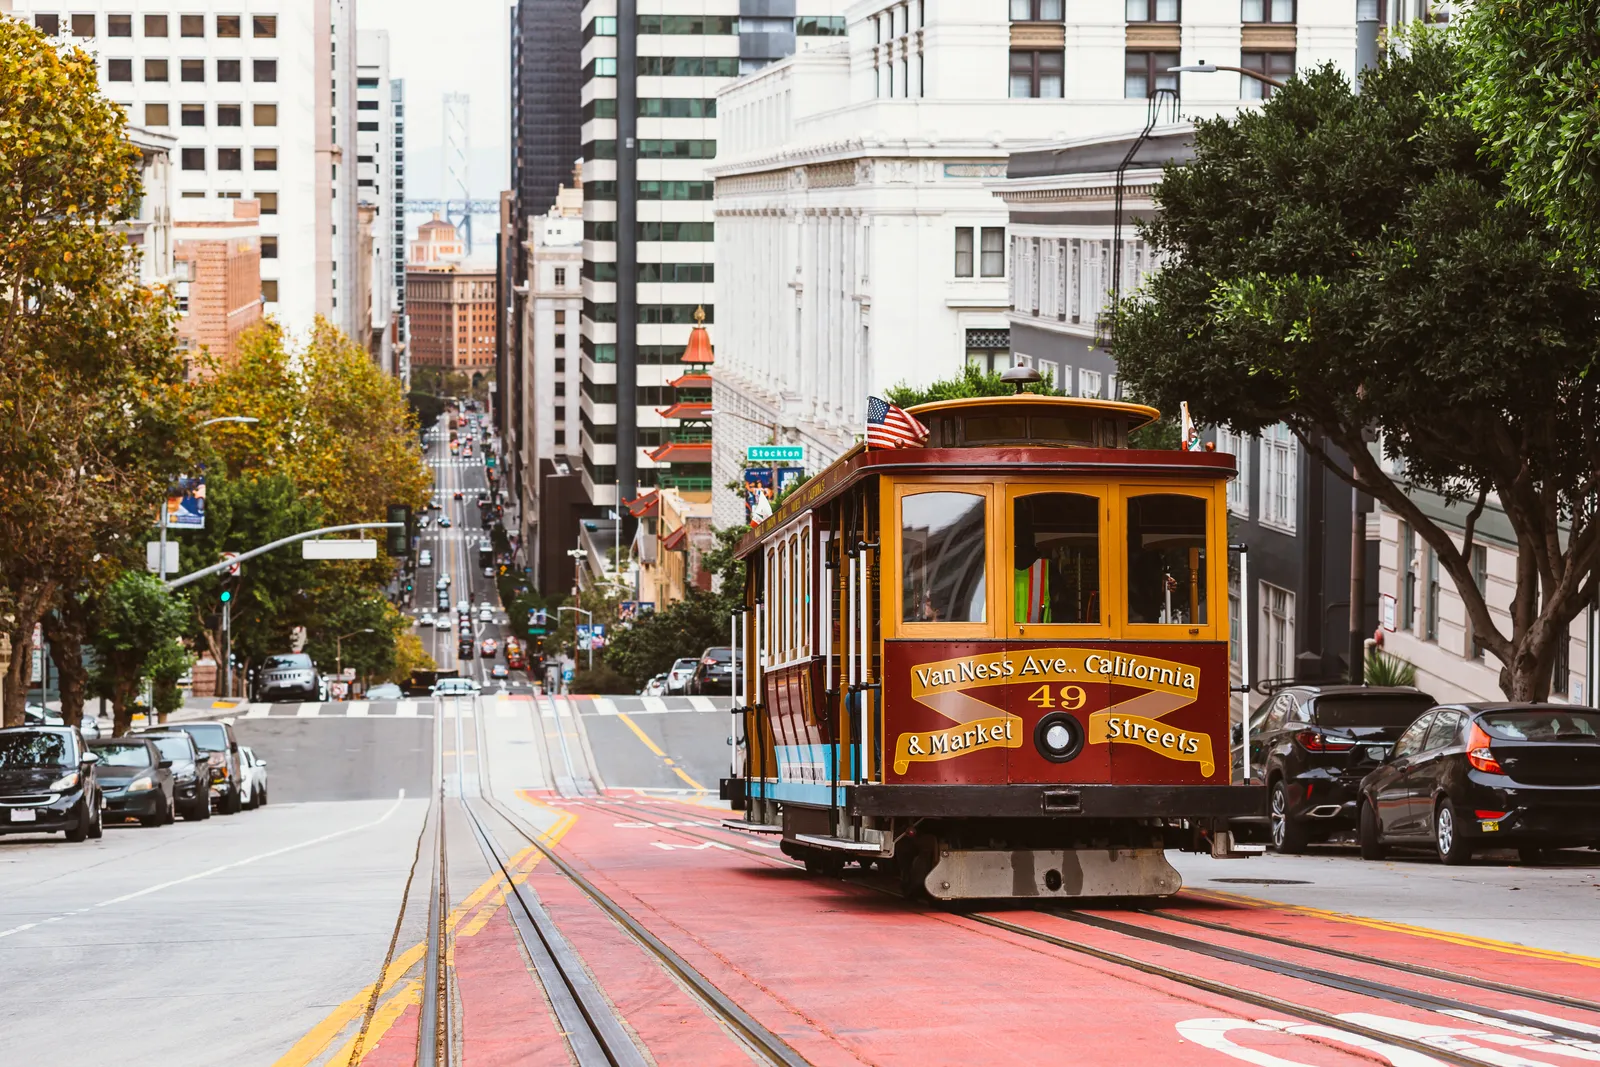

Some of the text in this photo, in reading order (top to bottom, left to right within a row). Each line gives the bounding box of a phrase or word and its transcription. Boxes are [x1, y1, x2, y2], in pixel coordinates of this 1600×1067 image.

[752, 449, 799, 457] Stockton
[1084, 654, 1195, 689] California
[1027, 685, 1087, 710] 49
[908, 718, 1199, 755] & Market Streets
